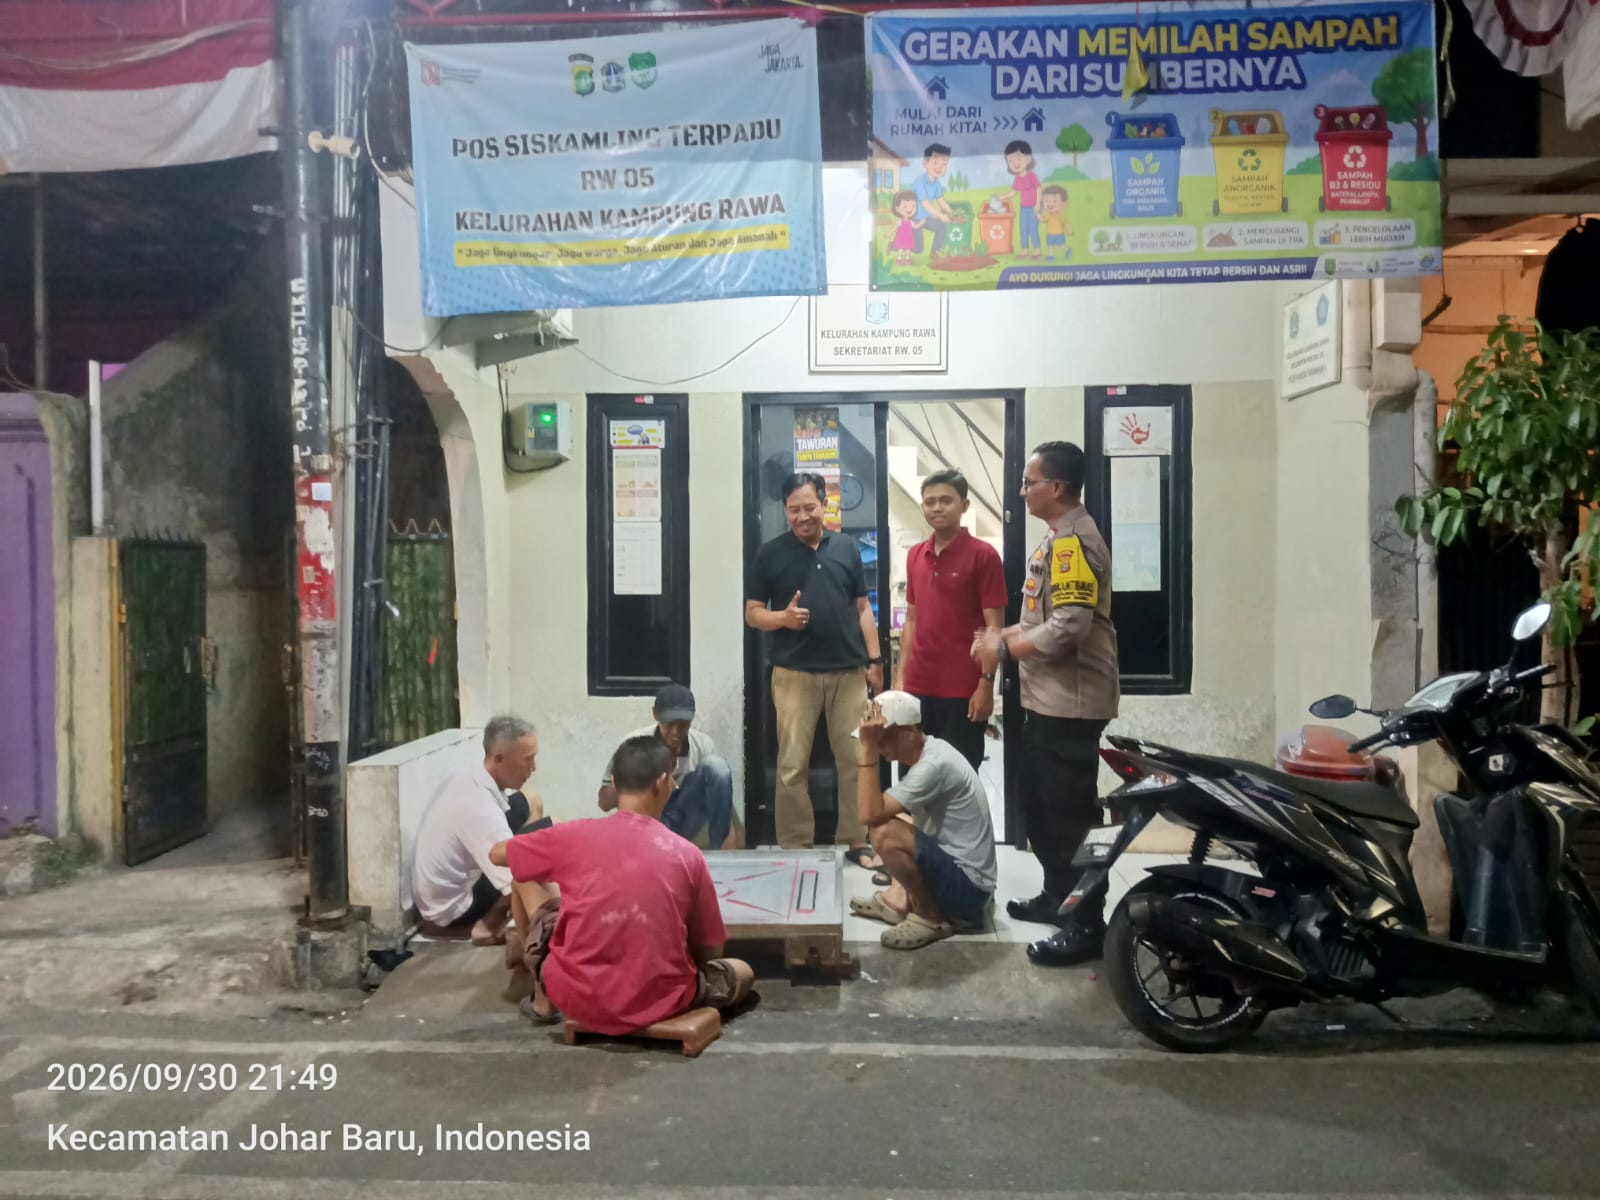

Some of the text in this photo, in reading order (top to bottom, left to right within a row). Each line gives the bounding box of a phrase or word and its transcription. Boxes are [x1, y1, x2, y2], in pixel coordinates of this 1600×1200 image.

[904, 15, 1398, 61] GERAKAN MEMILAH SAMPAH
[995, 63, 1078, 95] DARI
[946, 105, 982, 119] DARI
[890, 121, 987, 136] RUMAH KITA!
[452, 117, 782, 159] POS SISKAMLING TERPADU
[581, 167, 655, 192] RW 05
[1337, 171, 1373, 180] SAMPAH
[1350, 180, 1381, 190] RESIDU
[455, 193, 786, 233] KELURAHAN KAMPUNG RAWA
[1009, 272, 1028, 282] AYO
[1074, 271, 1100, 281] JAGA
[1167, 267, 1188, 278] KITA
[1190, 266, 1220, 277] TETAP
[1222, 265, 1257, 277] BERSIH
[1259, 264, 1280, 275] DAN
[820, 328, 937, 339] KELURAHAN KAMPUNG RAWA
[833, 345, 923, 356] SEKRETARIAT RW. 05
